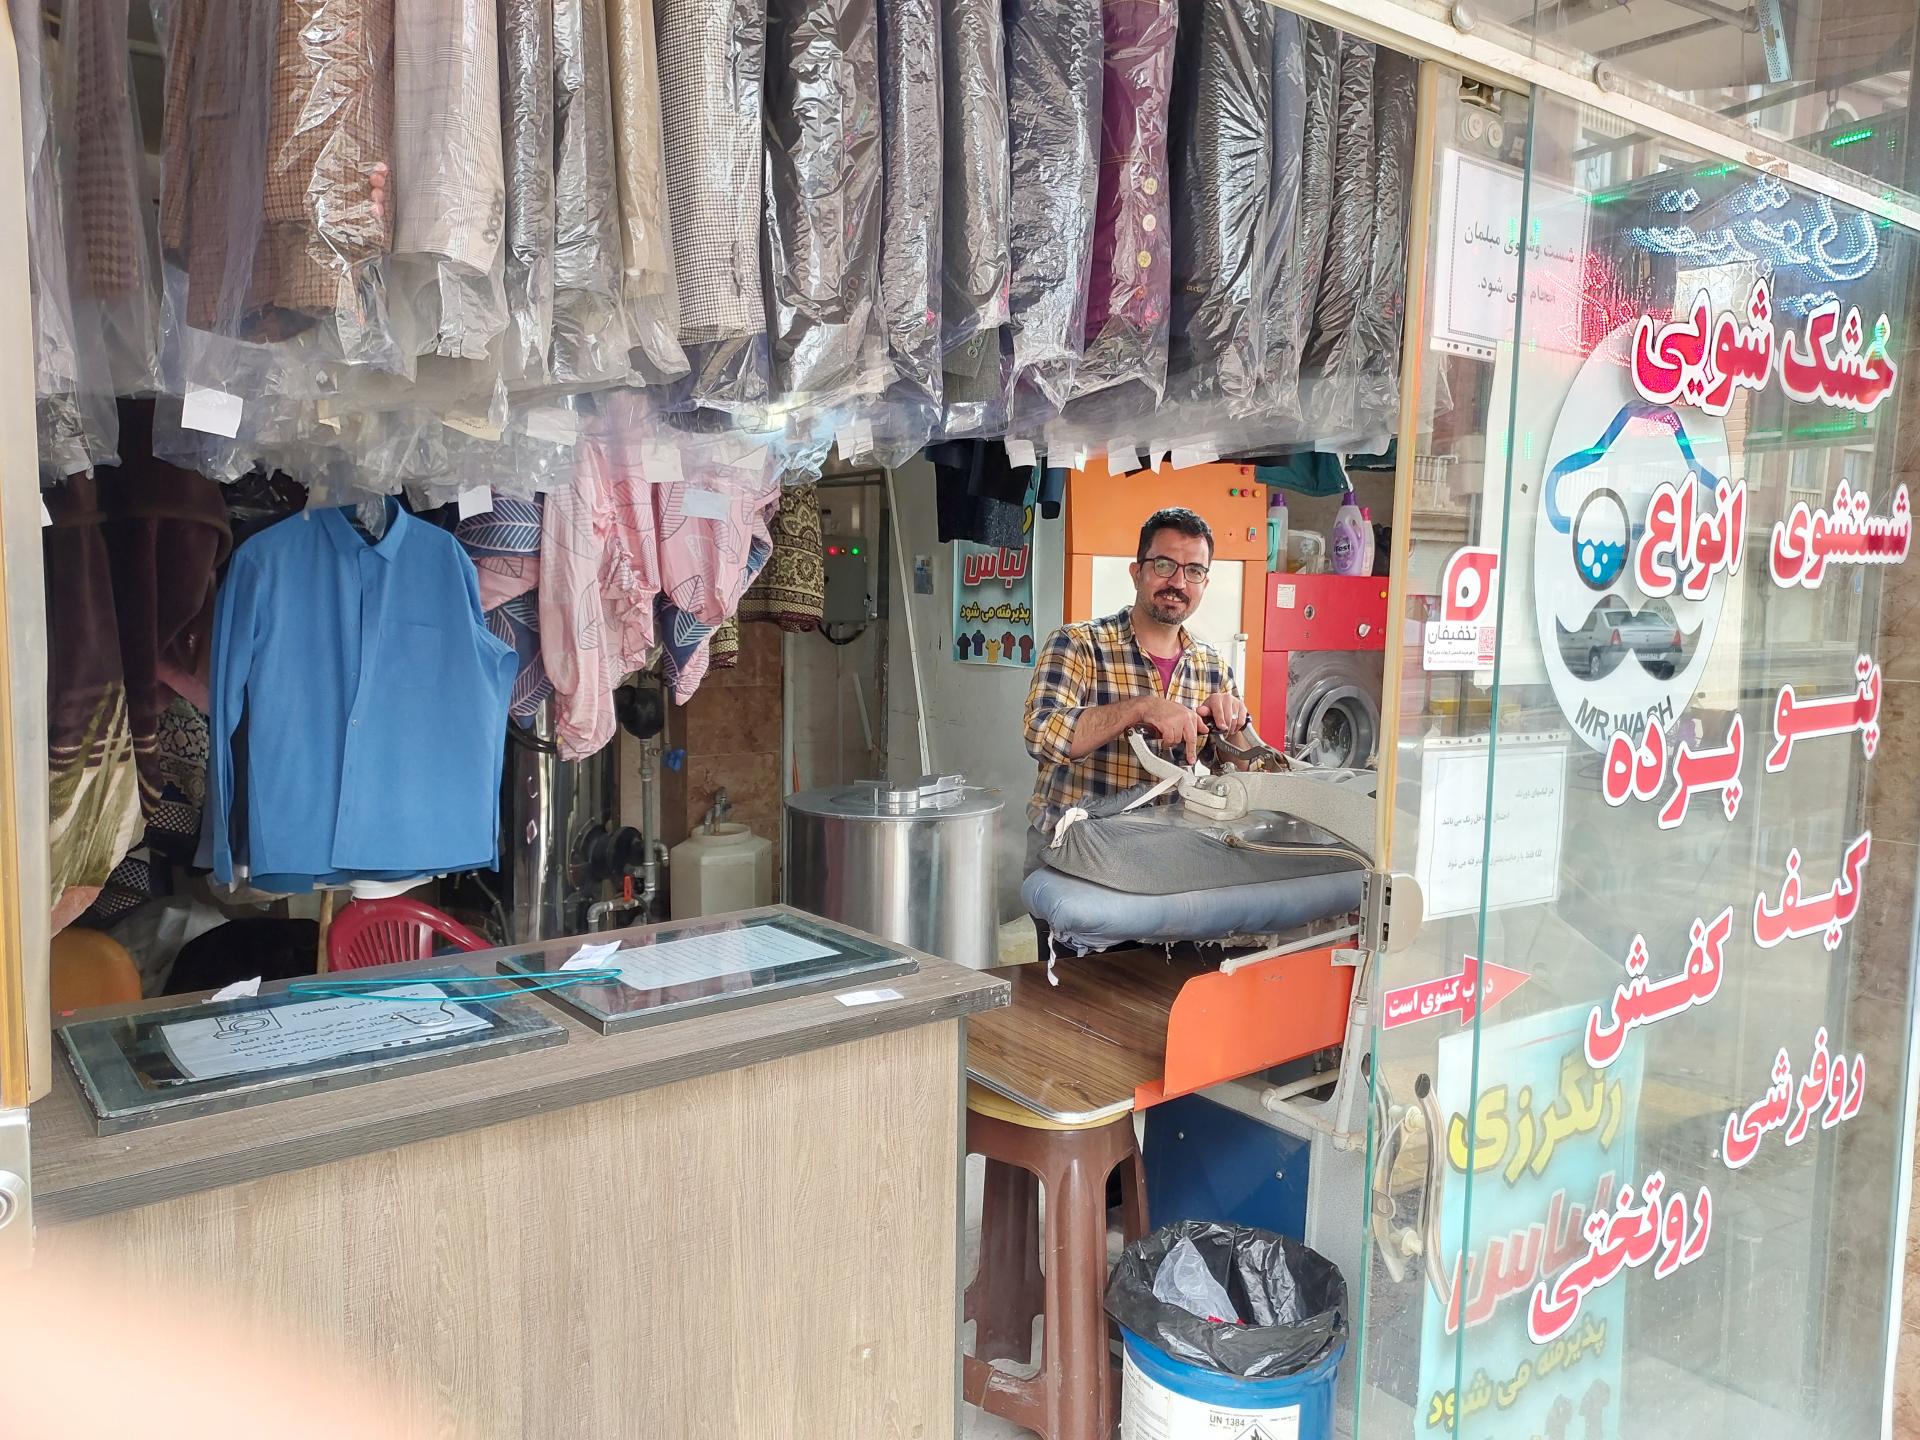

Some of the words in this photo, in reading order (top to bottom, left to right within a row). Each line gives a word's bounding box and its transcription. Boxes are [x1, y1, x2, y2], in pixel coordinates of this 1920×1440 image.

[1464, 221, 1501, 249] مبلمان
[1631, 278, 1773, 417] شویی
[1780, 302, 1898, 412] خشک
[964, 544, 1029, 588] لباس
[1635, 471, 1746, 600] انواع
[1771, 480, 1911, 589] شستشوی
[960, 602, 979, 622] شود
[981, 606, 995, 622] می
[996, 603, 1030, 625] پذیرفته
[1428, 625, 1477, 645] تخفیفان
[1765, 654, 1882, 773] پتو
[1603, 712, 1744, 830] پرده
[1753, 831, 1872, 952] کیف
[1387, 991, 1419, 1018] است
[1419, 979, 1461, 1017] کشوی
[1584, 904, 1733, 1068] کفش
[1722, 1027, 1865, 1169] روفرشی
[1527, 1171, 1712, 1344] روتختی
[1209, 1414, 1222, 1424] UN
[1225, 1418, 1245, 1426] 1384
[1497, 1358, 1532, 1409] می
